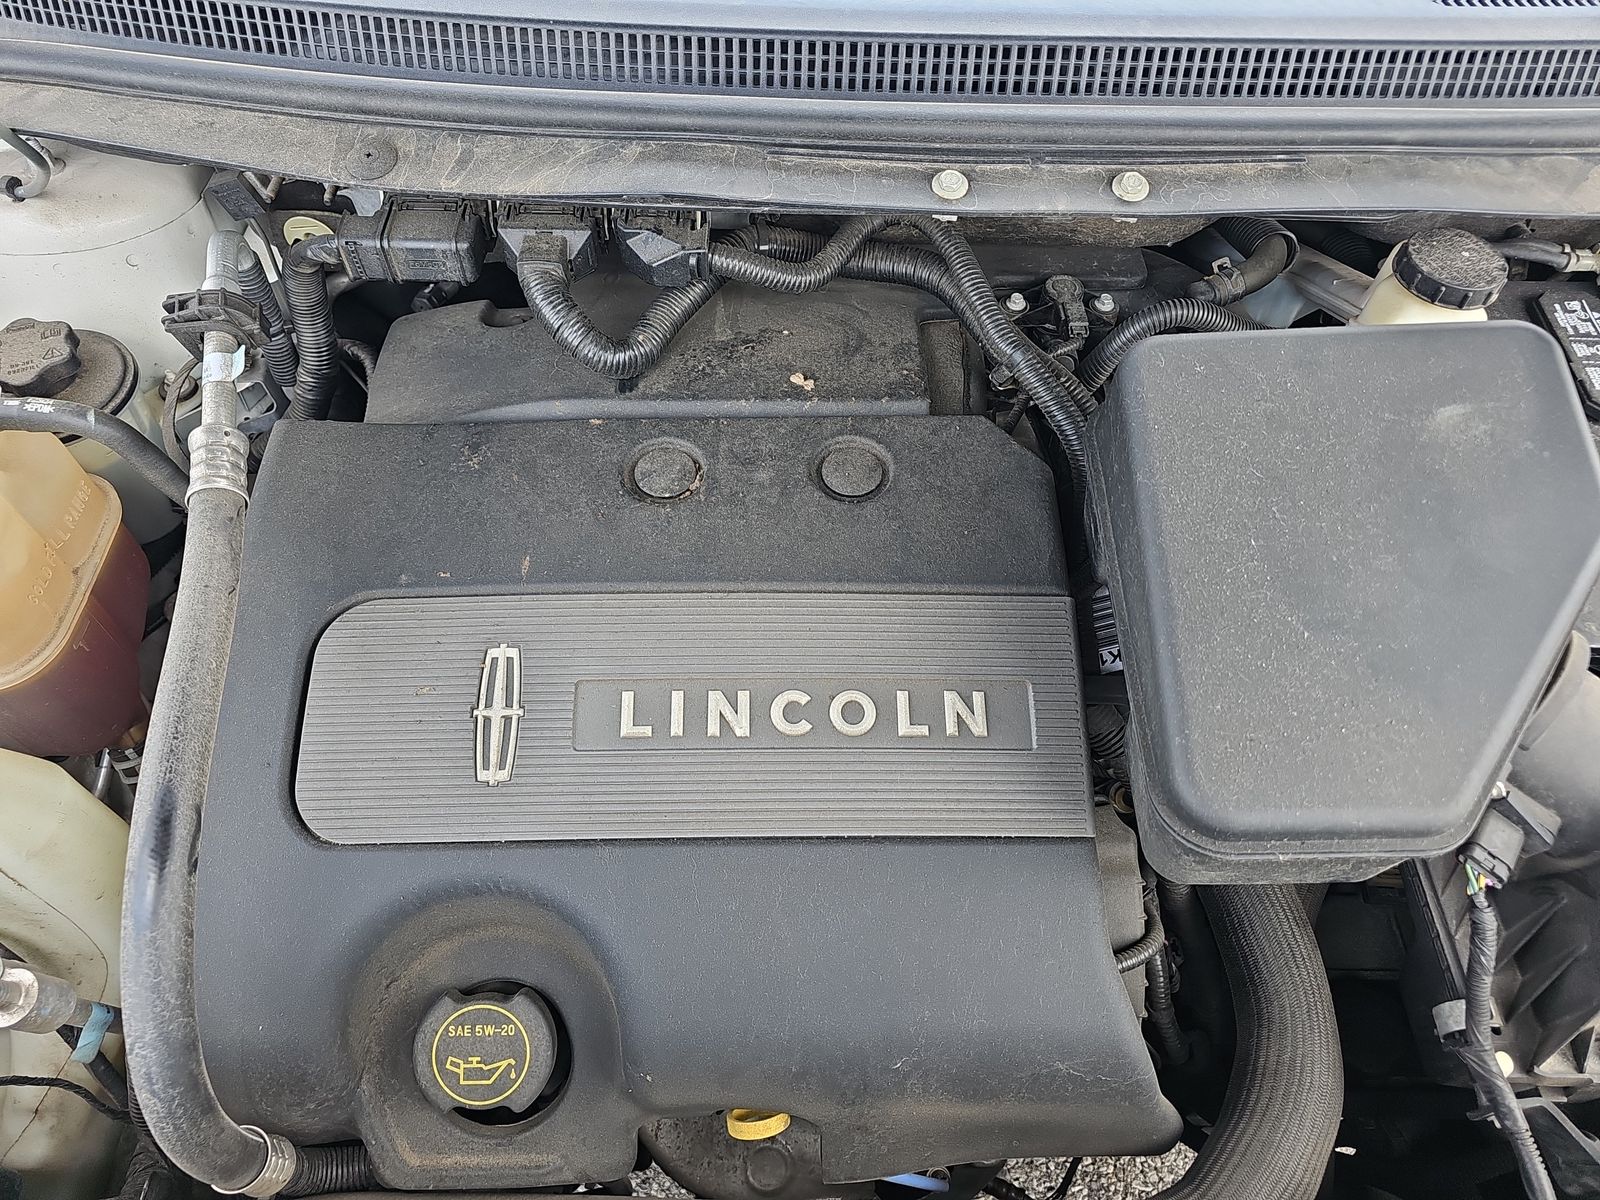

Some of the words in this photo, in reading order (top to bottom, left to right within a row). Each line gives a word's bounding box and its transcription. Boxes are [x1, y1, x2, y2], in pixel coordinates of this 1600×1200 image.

[64, 480, 92, 529] RANGE
[619, 689, 989, 739] LINCOLN
[448, 1025, 472, 1037] SAE
[475, 1024, 515, 1036] 5W-20
